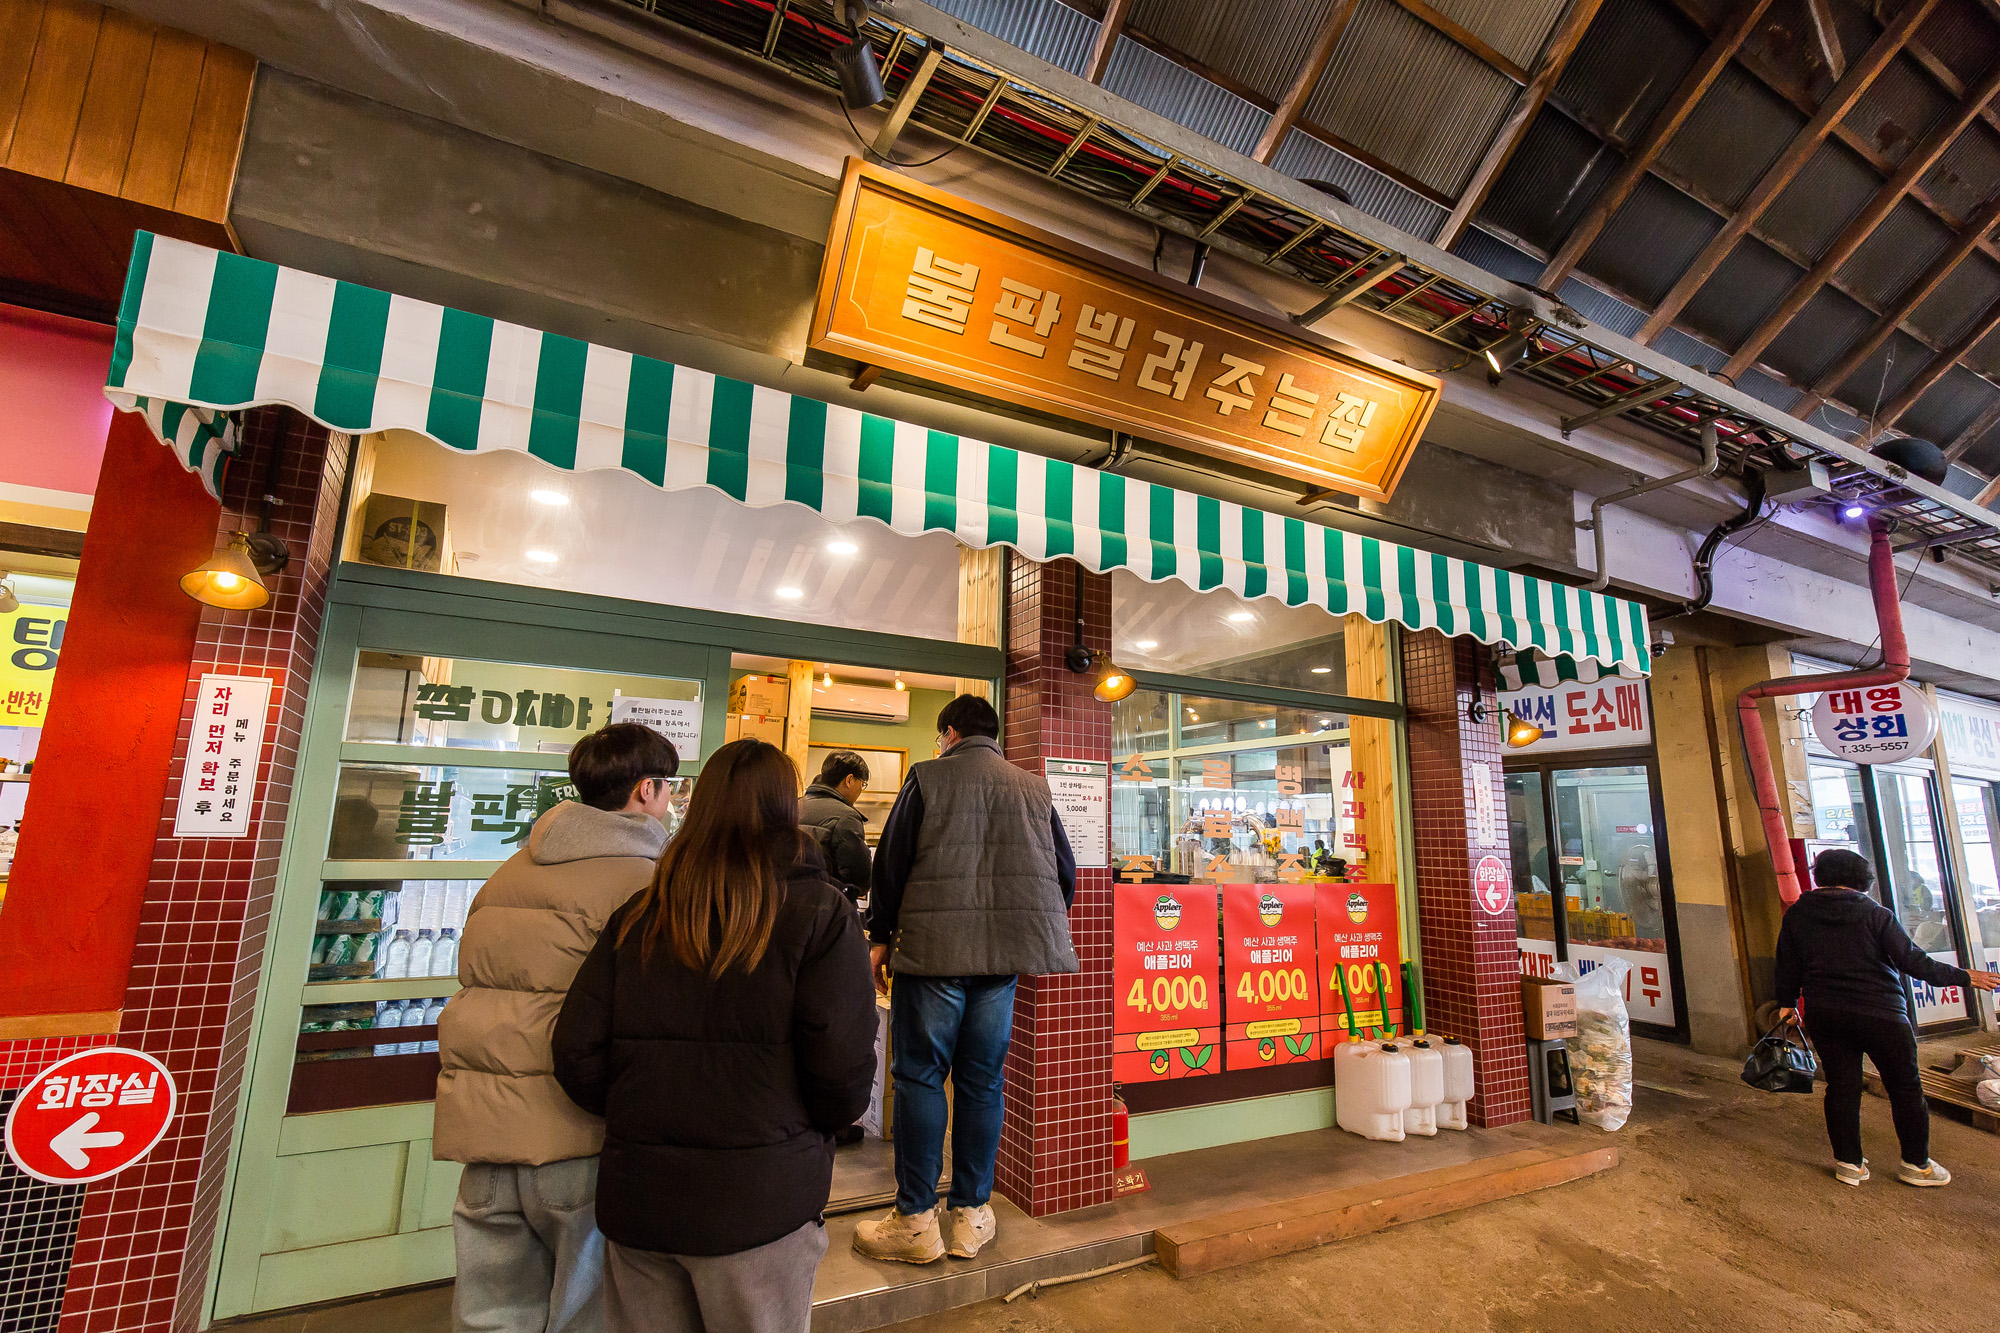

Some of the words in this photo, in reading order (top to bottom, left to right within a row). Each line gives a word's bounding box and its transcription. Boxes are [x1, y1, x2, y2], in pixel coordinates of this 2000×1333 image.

[212, 687, 233, 717] 자리
[1566, 683, 1643, 734] 도소매
[1828, 687, 1903, 714] 대영
[233, 718, 249, 743] 메뉴
[1832, 713, 1908, 741] 상회
[205, 724, 226, 755] 먼저
[1840, 741, 1909, 754] T.335-5557
[198, 761, 220, 792] 확보
[219, 758, 242, 822] 주문하세요
[194, 800, 212, 815] 후
[1066, 805, 1088, 813] 5,000원
[1479, 866, 1505, 882] 화장실
[1154, 903, 1182, 912] Appleer
[1258, 901, 1284, 910] Appleer
[1346, 899, 1368, 908] Appleer
[1243, 937, 1259, 947] 예산
[1261, 936, 1275, 946] 사과
[1277, 936, 1298, 946] 생맥주
[1334, 933, 1348, 943] 예산
[1349, 933, 1362, 942] 사과
[1364, 932, 1383, 942] 생맥주
[1136, 941, 1154, 952] 예산
[1156, 941, 1172, 951] 사과
[1174, 940, 1198, 951] 생맥주
[1340, 944, 1378, 958] 애플리어
[1144, 954, 1192, 970] 애플리어
[1250, 949, 1293, 964] 애플리어
[1640, 966, 1661, 1007] 무
[36, 1071, 159, 1110] 화장실
[1116, 1172, 1144, 1188] 소화기
